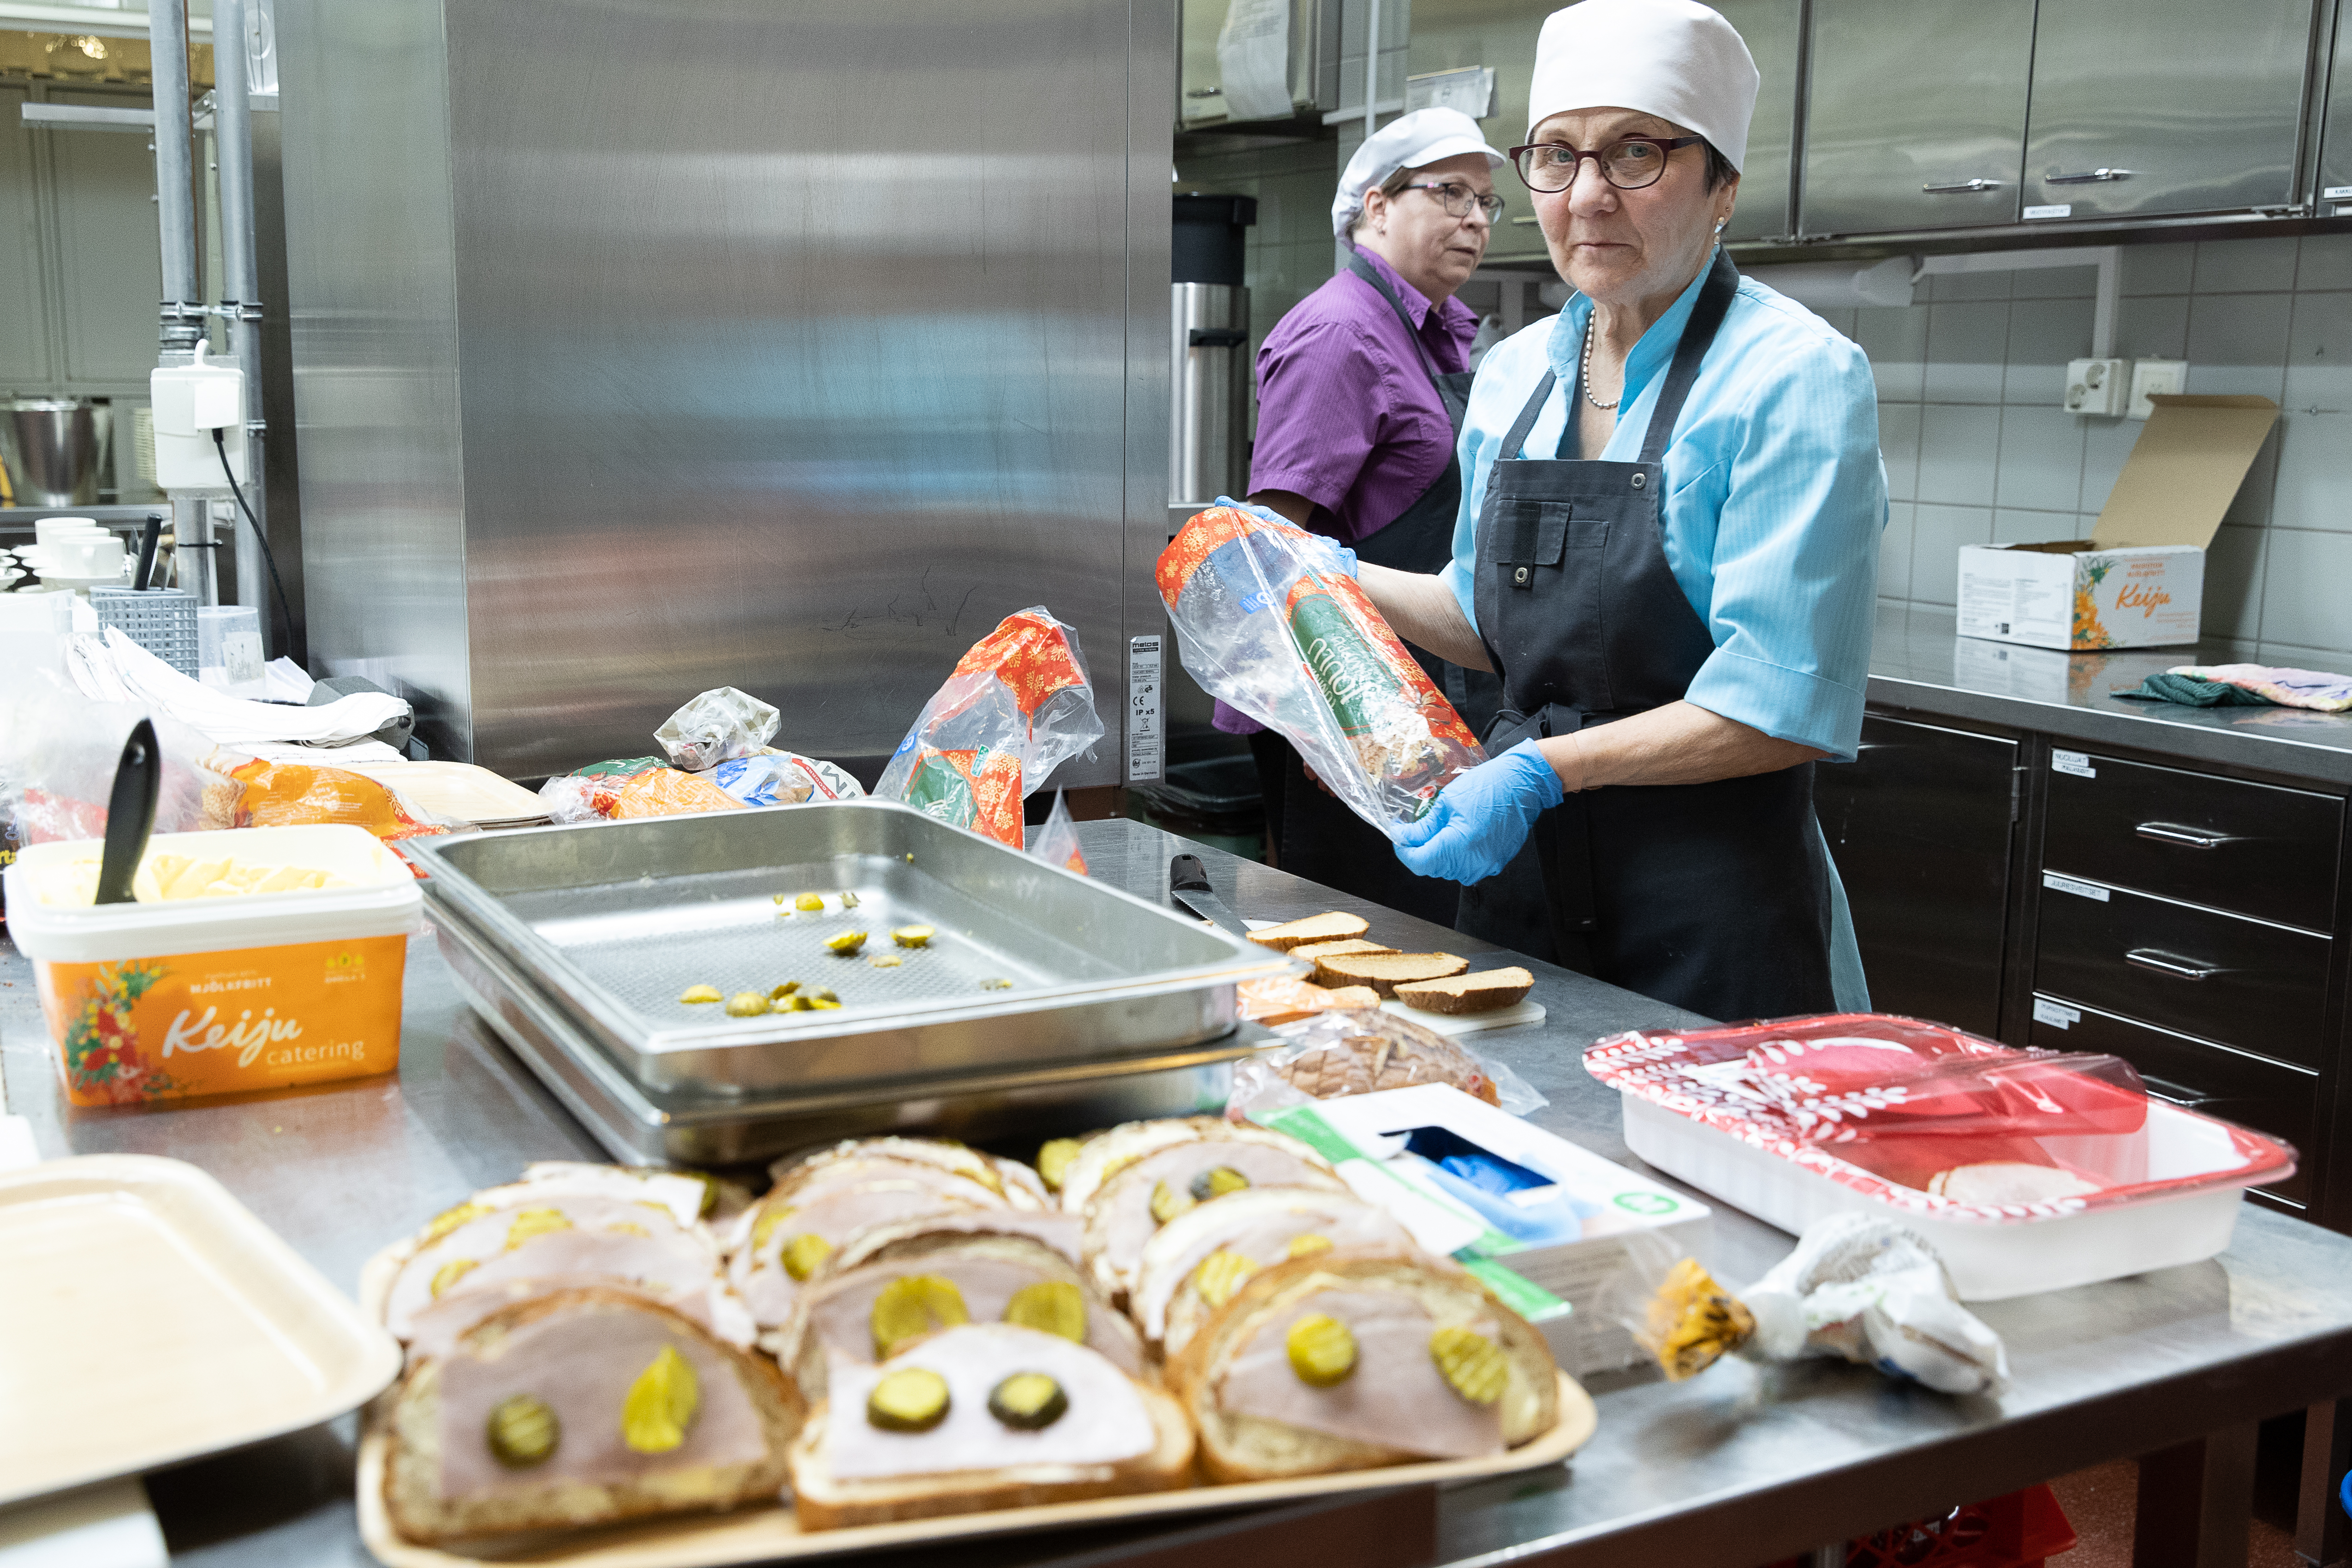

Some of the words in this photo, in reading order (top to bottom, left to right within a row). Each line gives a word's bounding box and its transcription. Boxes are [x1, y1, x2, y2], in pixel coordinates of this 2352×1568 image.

[2115, 583, 2171, 619] Keiju
[805, 766, 827, 791] GODARE
[161, 1006, 303, 1068] Keiju
[267, 1040, 364, 1065] catering
